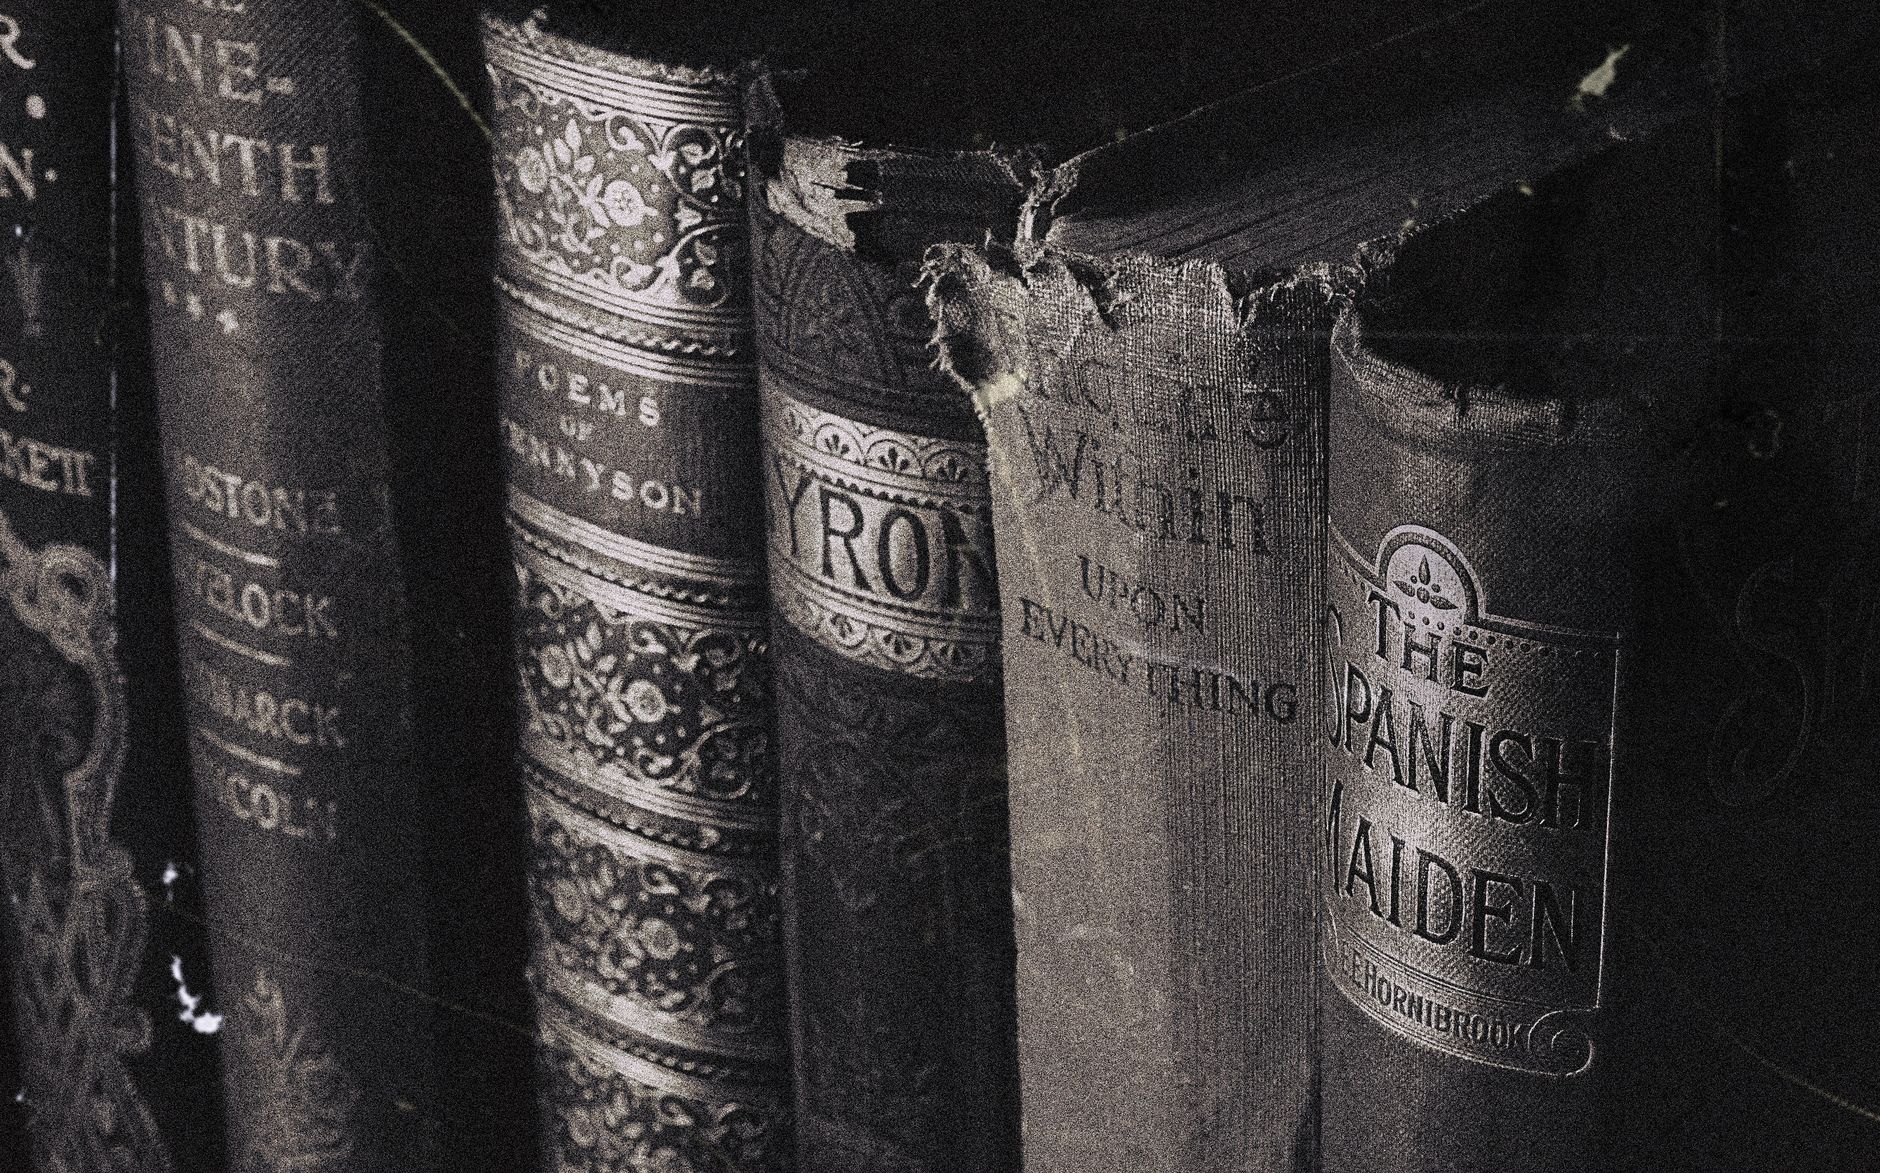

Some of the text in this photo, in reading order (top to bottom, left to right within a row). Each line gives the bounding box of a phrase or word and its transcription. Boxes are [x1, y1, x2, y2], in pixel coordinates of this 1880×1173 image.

[514, 350, 662, 428] POEMS
[502, 420, 702, 517] ENNYSON
[1078, 554, 1206, 635] UPON
[1370, 591, 1491, 698] THE
[1018, 597, 1299, 724] EVERYTHING
[1325, 603, 1600, 831] SPANISH
